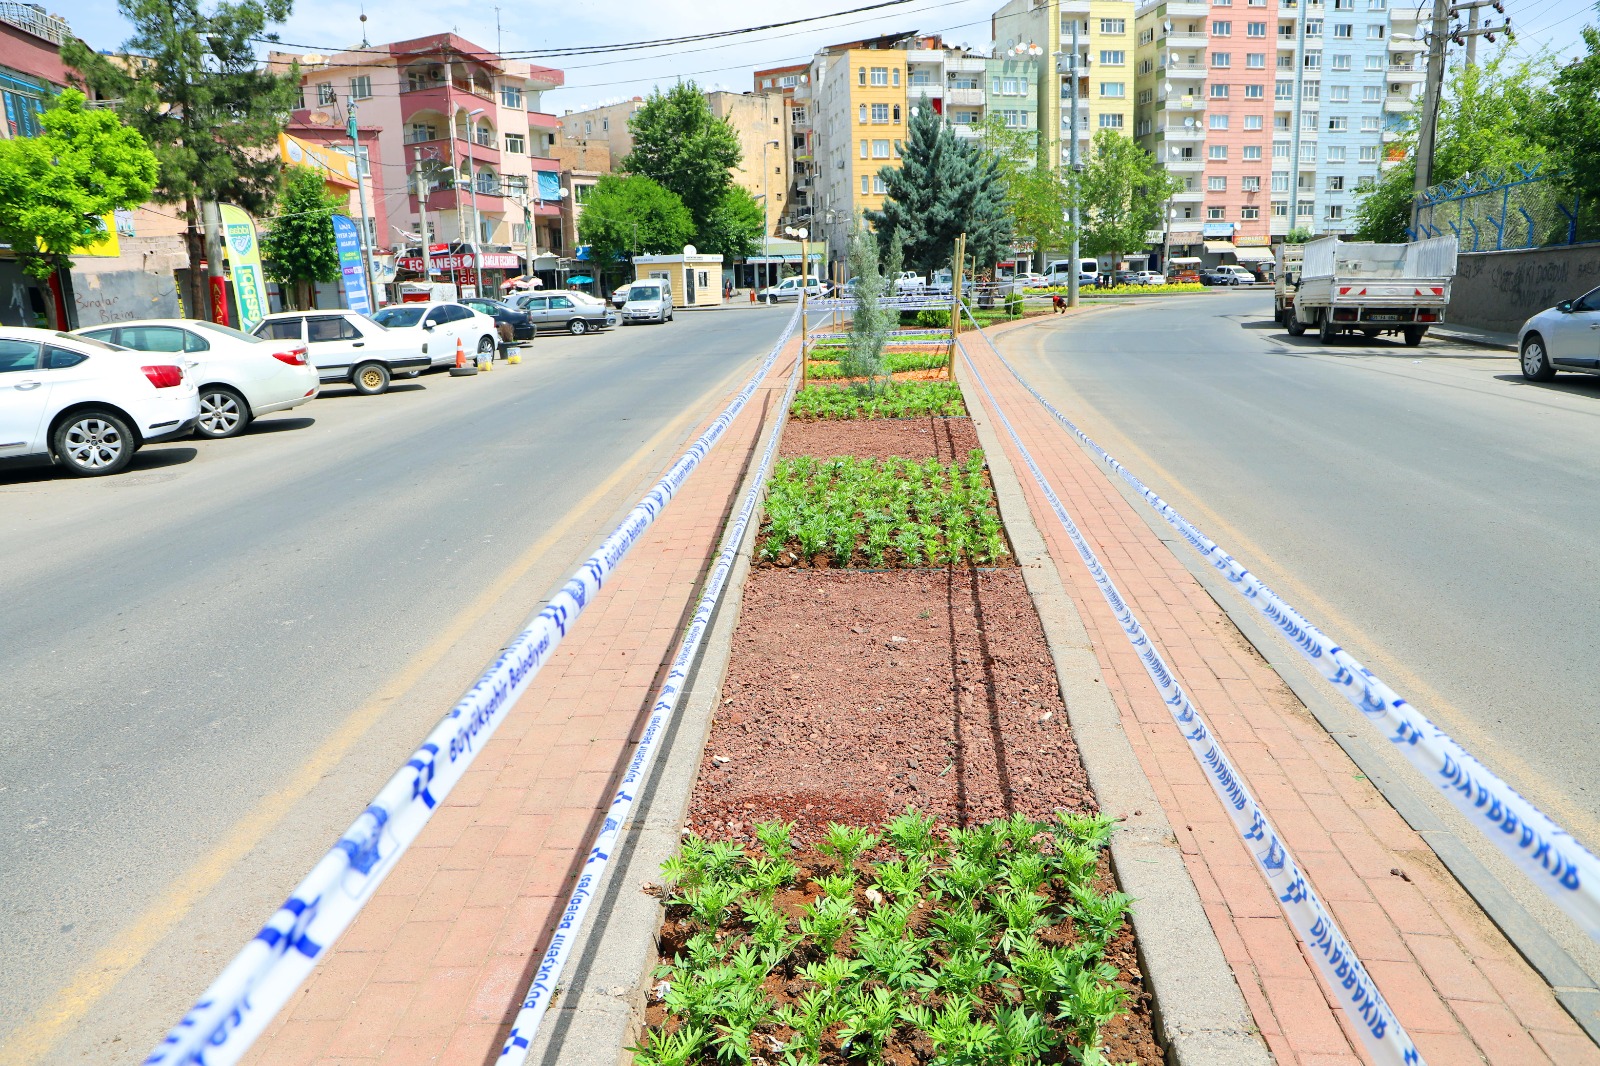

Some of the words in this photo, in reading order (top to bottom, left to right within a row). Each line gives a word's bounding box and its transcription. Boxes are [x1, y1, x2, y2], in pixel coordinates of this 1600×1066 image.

[409, 257, 461, 271] ECANESİ
[449, 679, 508, 763] Büyükşehir
[509, 627, 550, 690] Belediyesi
